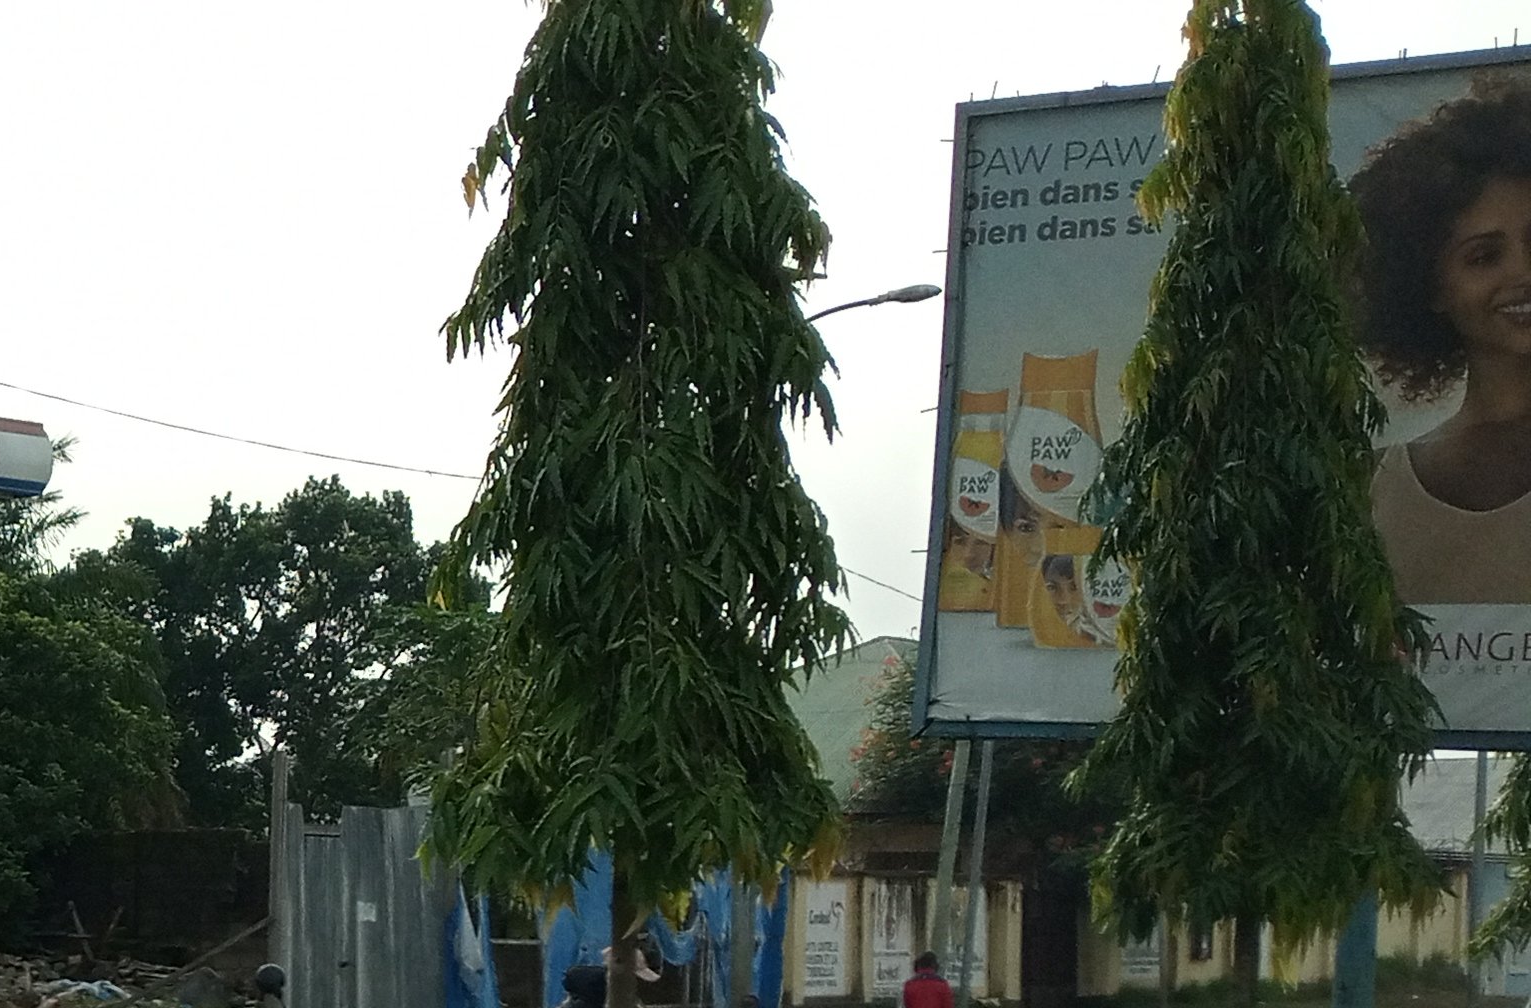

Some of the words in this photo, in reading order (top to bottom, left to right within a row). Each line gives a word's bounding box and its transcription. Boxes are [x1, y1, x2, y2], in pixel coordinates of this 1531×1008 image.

[967, 143, 1052, 177] PAW
[1064, 134, 1156, 171] PAW
[963, 184, 1029, 211] bien
[1040, 179, 1119, 206] dans
[961, 219, 1026, 246] bien
[1036, 215, 1116, 241] dans
[1032, 436, 1072, 449] PAW
[1031, 448, 1071, 461] PAW
[960, 476, 989, 487] PAW
[959, 485, 988, 495] PAW
[1092, 588, 1123, 598] PAW
